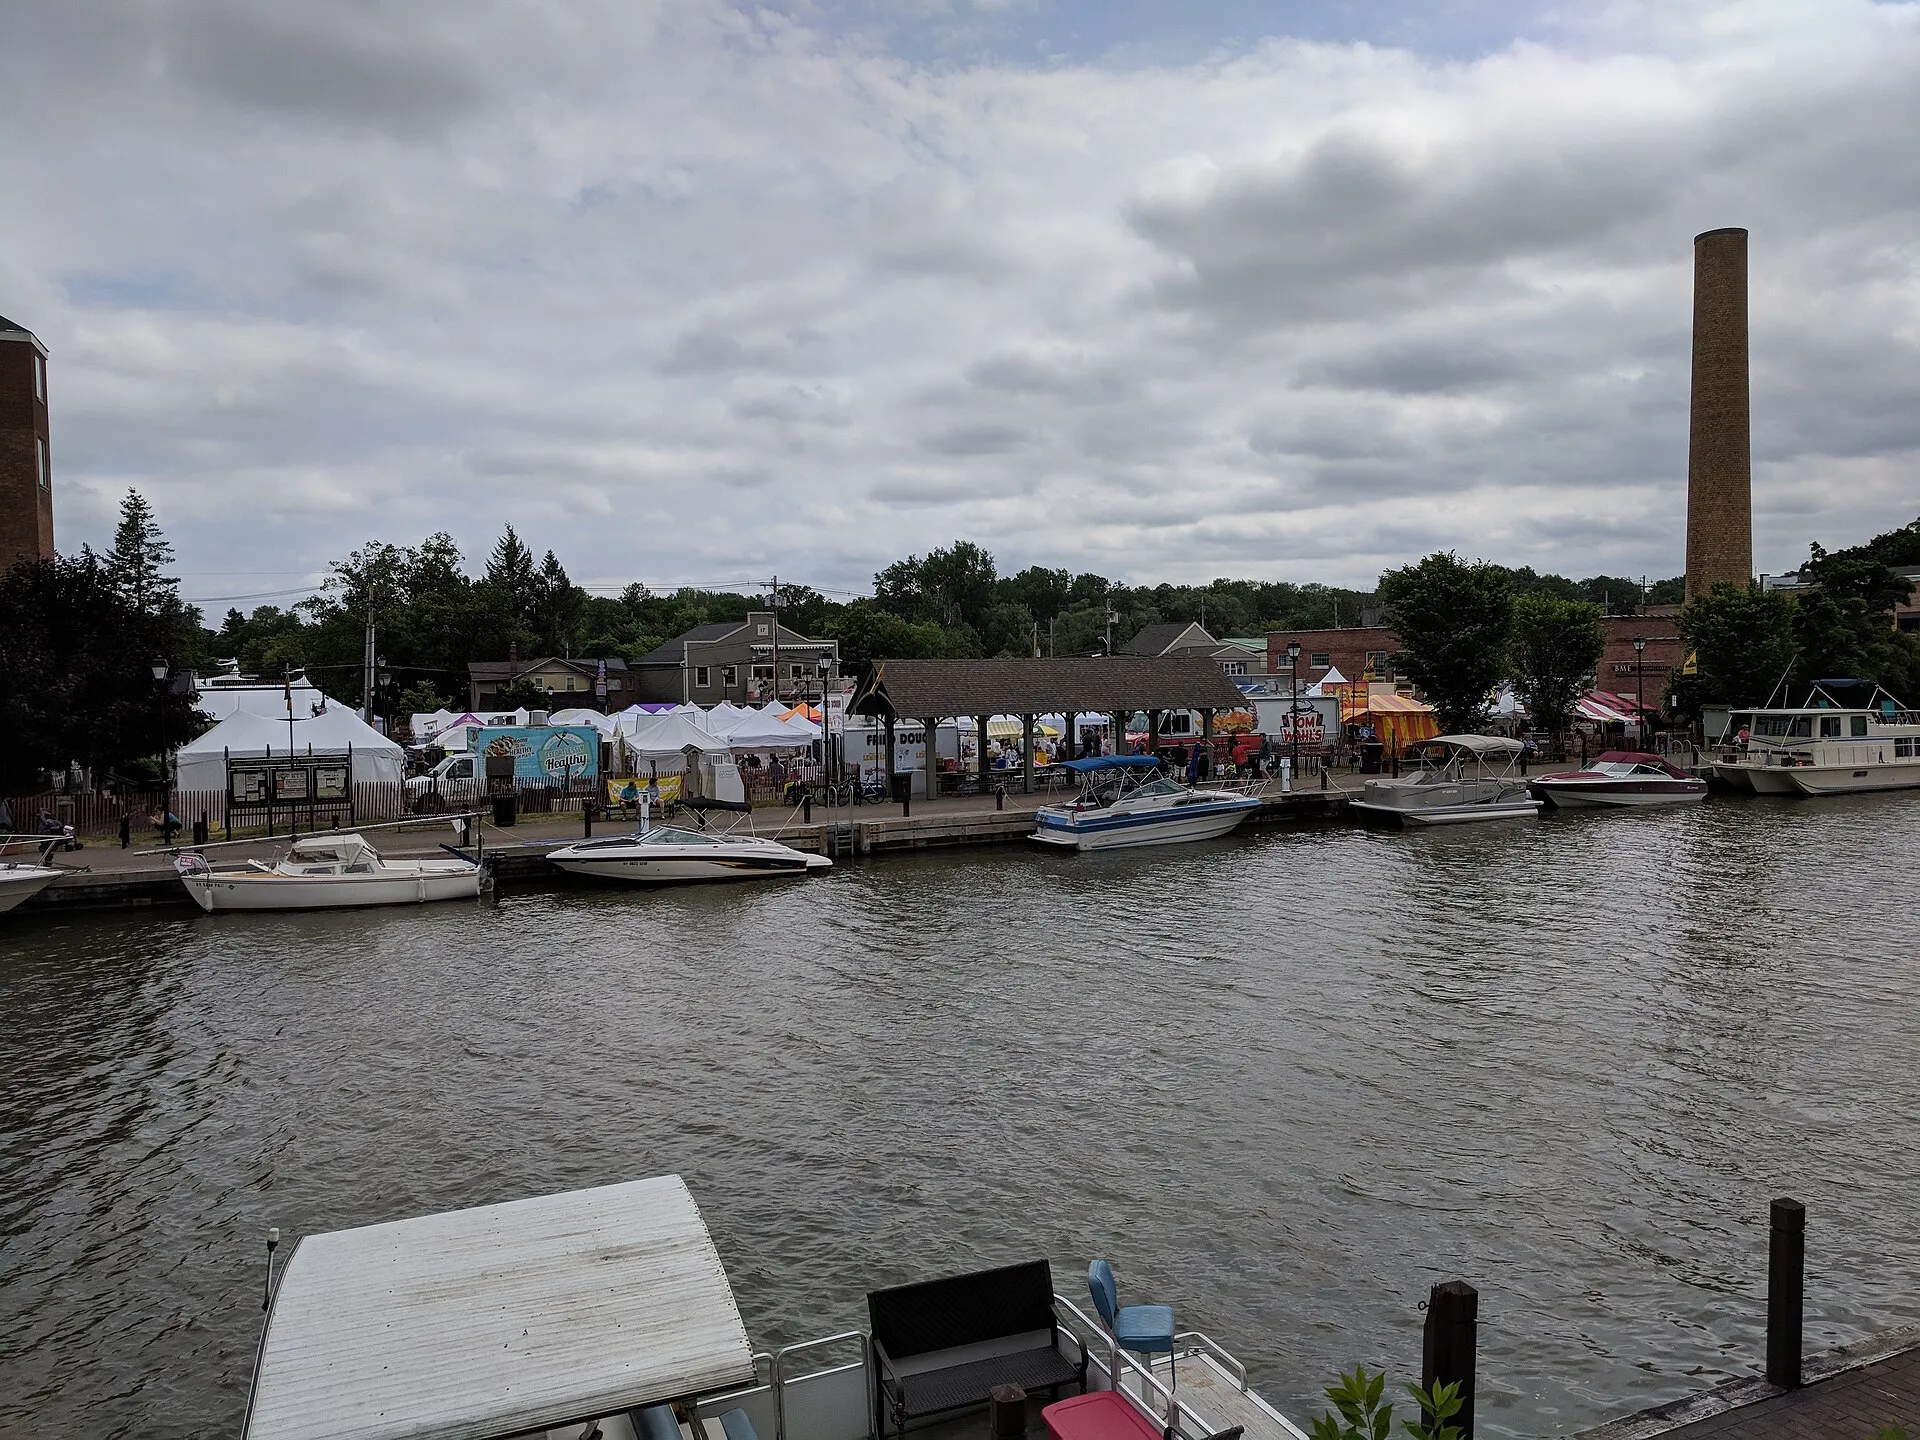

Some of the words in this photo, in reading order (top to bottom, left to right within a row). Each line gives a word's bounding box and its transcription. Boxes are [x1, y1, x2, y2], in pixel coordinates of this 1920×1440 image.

[1290, 715, 1315, 728] TOM
[509, 747, 532, 756] HEALTHY
[546, 755, 587, 770] Healthy
